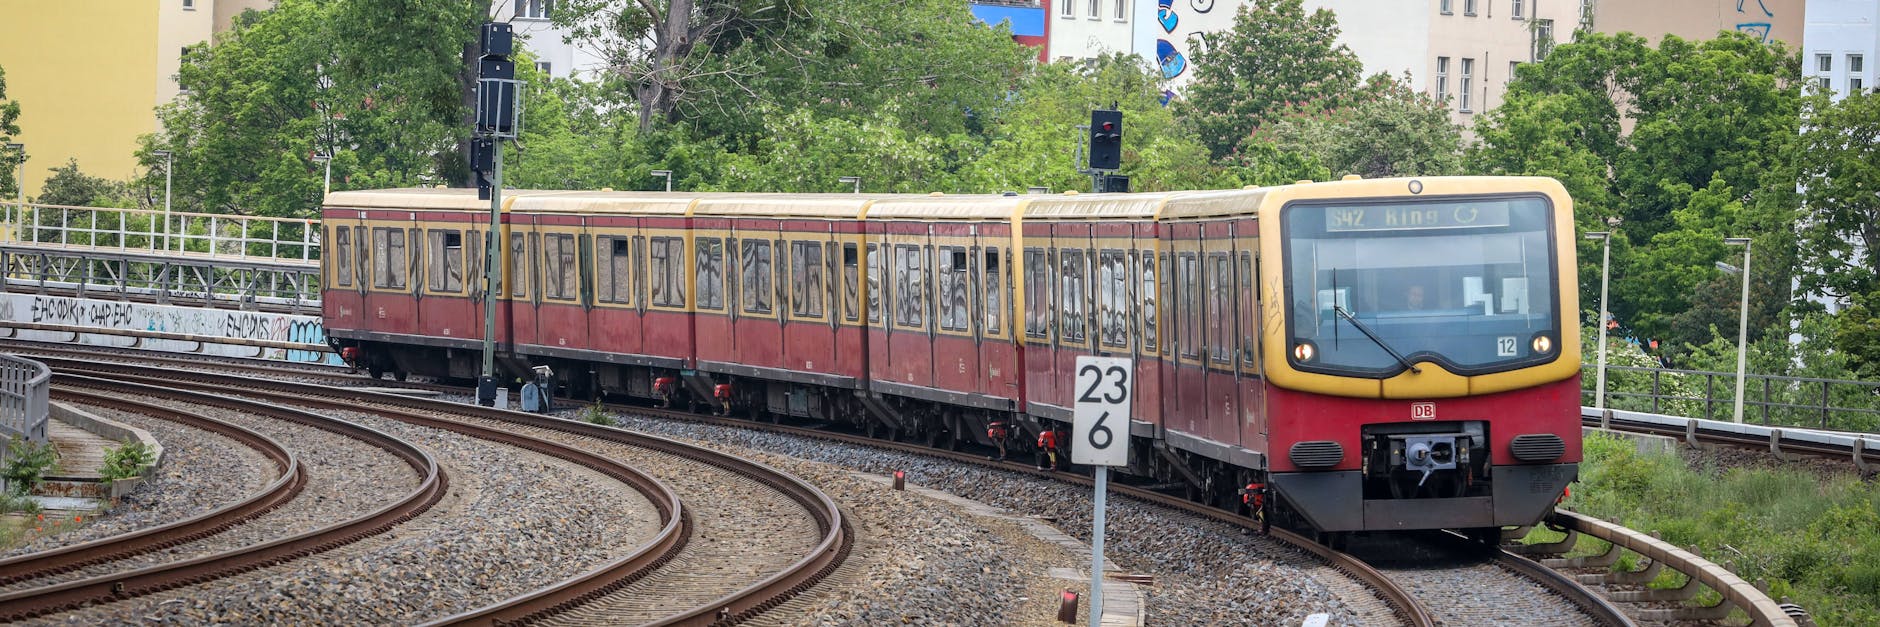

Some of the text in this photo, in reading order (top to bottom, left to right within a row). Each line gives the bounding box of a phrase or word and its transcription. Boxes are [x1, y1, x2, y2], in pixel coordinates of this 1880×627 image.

[1332, 207, 1439, 227] S42 Ring
[1499, 338, 1516, 354] 12
[1077, 364, 1128, 405] 23
[1414, 406, 1434, 417] DB
[1088, 410, 1114, 450] 6
